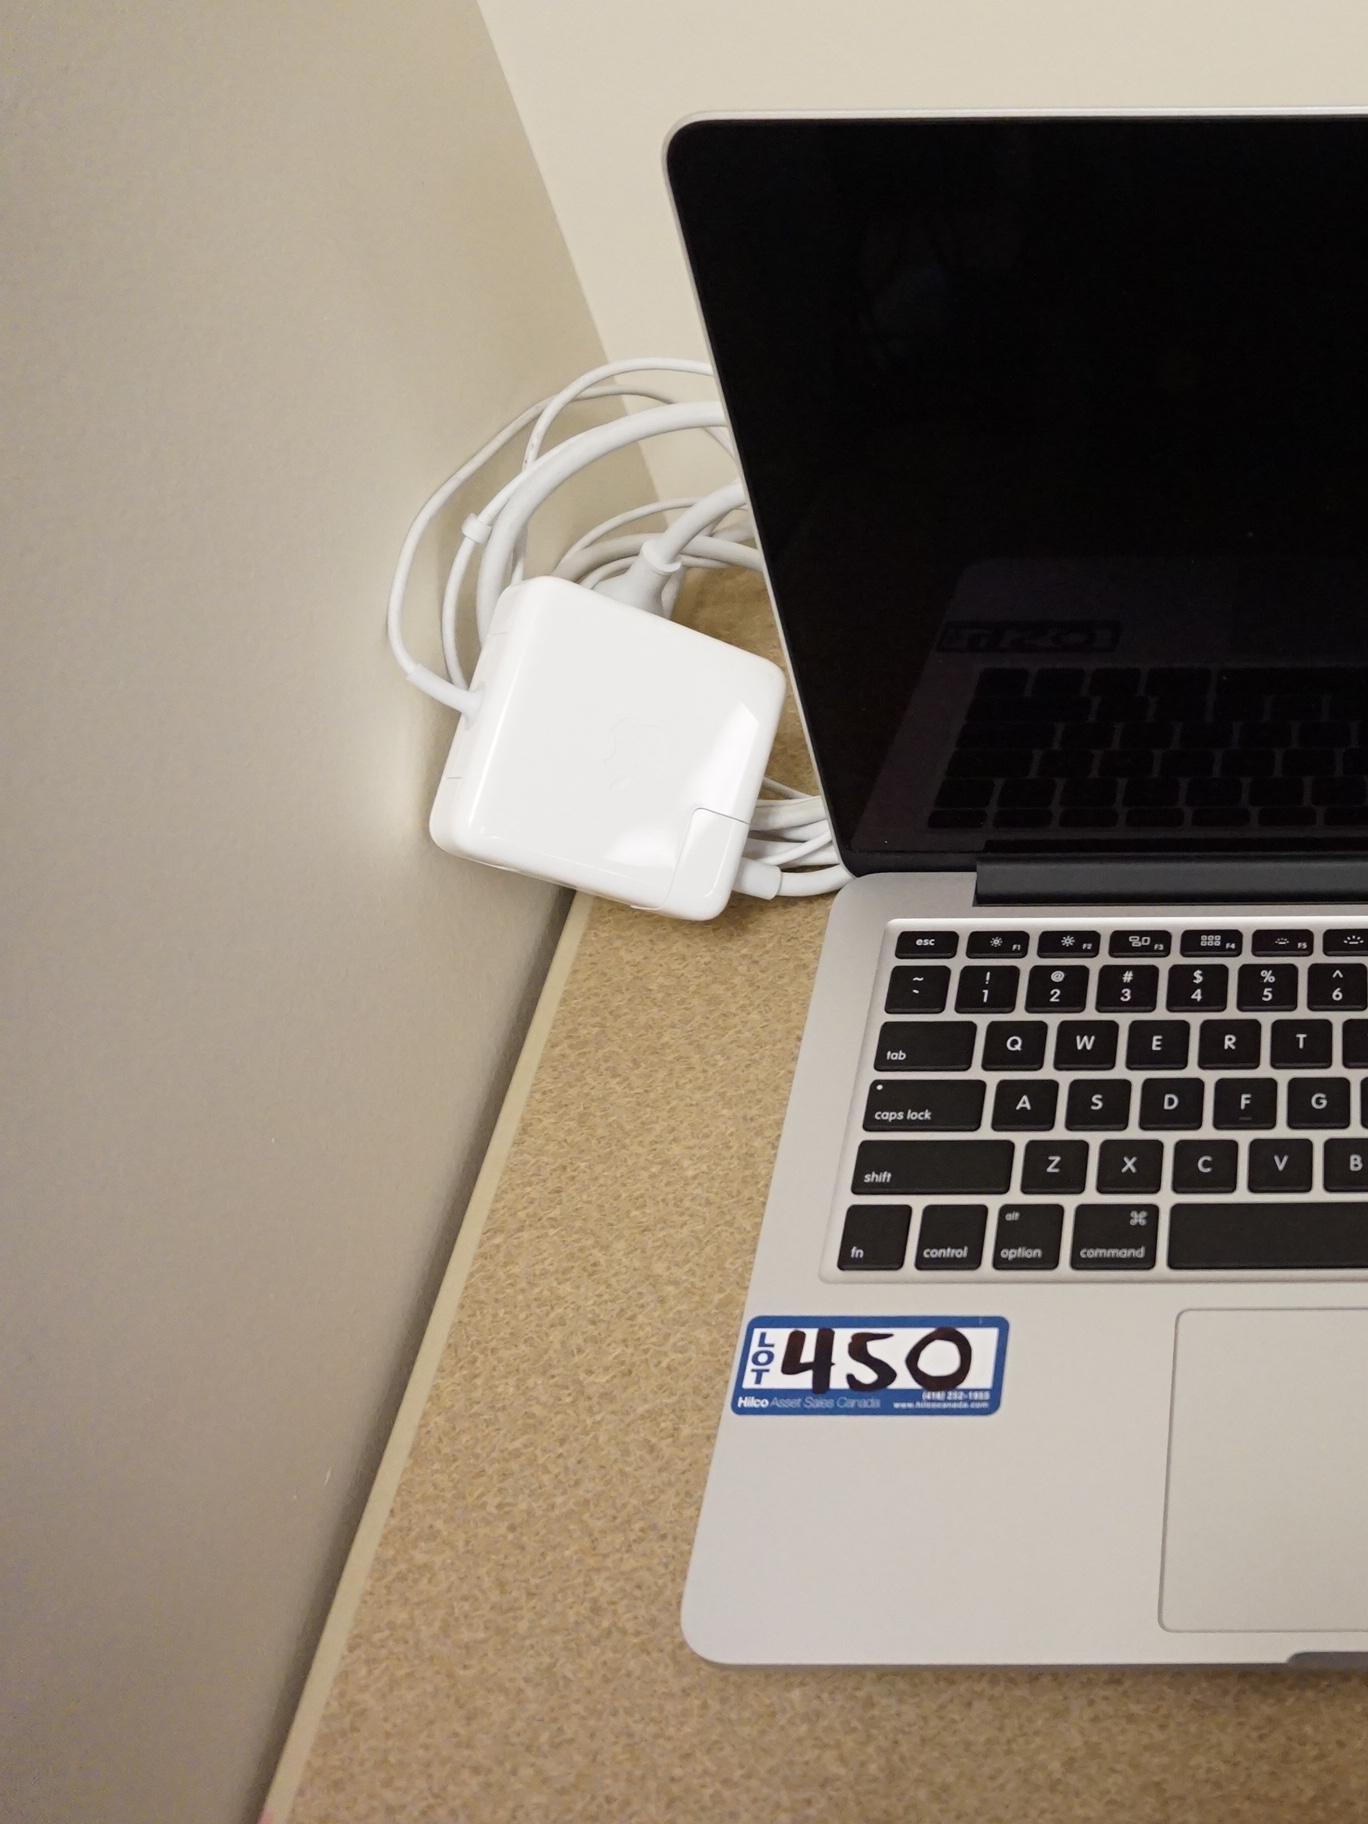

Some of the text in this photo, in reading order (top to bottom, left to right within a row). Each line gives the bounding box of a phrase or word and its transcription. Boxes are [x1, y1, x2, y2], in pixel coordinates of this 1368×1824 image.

[1051, 971, 1064, 982] @
[1123, 971, 1133, 982] #
[1193, 970, 1203, 983] $
[1261, 970, 1275, 982] %
[1050, 989, 1060, 1001] 2
[1121, 989, 1131, 1001] 3
[1191, 989, 1202, 1001] 4
[1262, 988, 1272, 1001] 5
[1332, 988, 1342, 1000] 6
[1007, 1036, 1022, 1050] Q
[1077, 1036, 1095, 1050] W
[1152, 1036, 1162, 1050] E
[1225, 1035, 1236, 1049] R
[1296, 1034, 1306, 1048] T
[887, 1050, 906, 1060] tab
[1016, 1095, 1030, 1110] A
[1091, 1095, 1102, 1109] S
[1164, 1094, 1178, 1109] D
[1241, 1094, 1251, 1109] F
[1312, 1093, 1327, 1109] G
[875, 1109, 931, 1121] caps lock
[1047, 1156, 1060, 1172] Z
[1122, 1157, 1136, 1172] X
[1198, 1156, 1211, 1172] C
[1274, 1156, 1288, 1171] V
[1350, 1155, 1362, 1171] B
[864, 1172, 891, 1182] shift
[1005, 1212, 1019, 1220] alt
[851, 1246, 863, 1257] fn
[923, 1246, 968, 1258] control
[1001, 1247, 1042, 1260] option
[1080, 1246, 1145, 1258] command
[751, 1332, 774, 1385] LOT
[781, 1327, 972, 1394] 450
[737, 1396, 880, 1408] Hilco Asset Sales Canada
